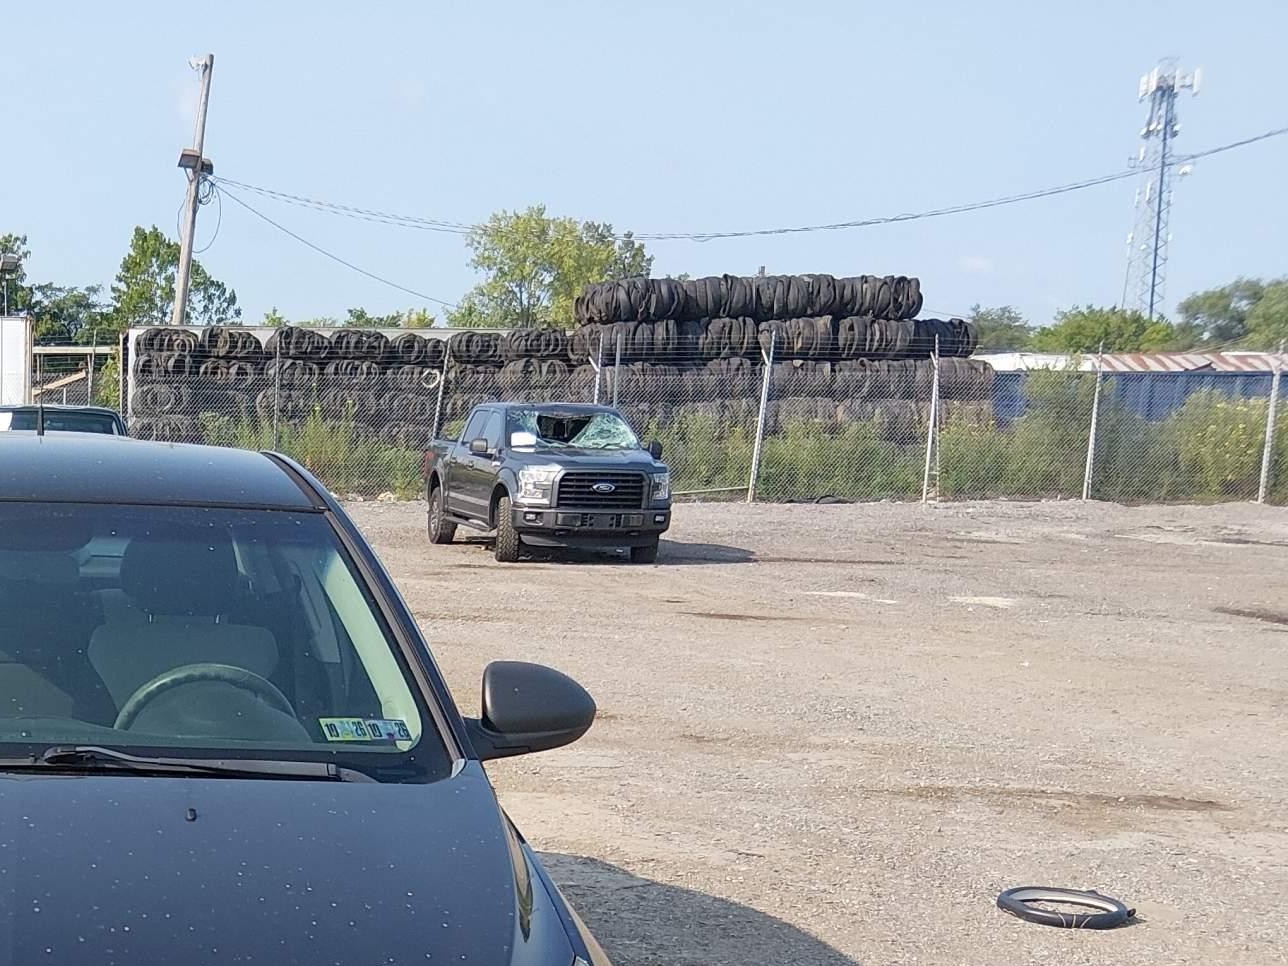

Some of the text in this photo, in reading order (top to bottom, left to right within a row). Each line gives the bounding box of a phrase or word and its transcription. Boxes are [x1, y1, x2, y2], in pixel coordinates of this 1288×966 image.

[324, 721, 368, 738] 10 26
[368, 721, 411, 738] 10 26
